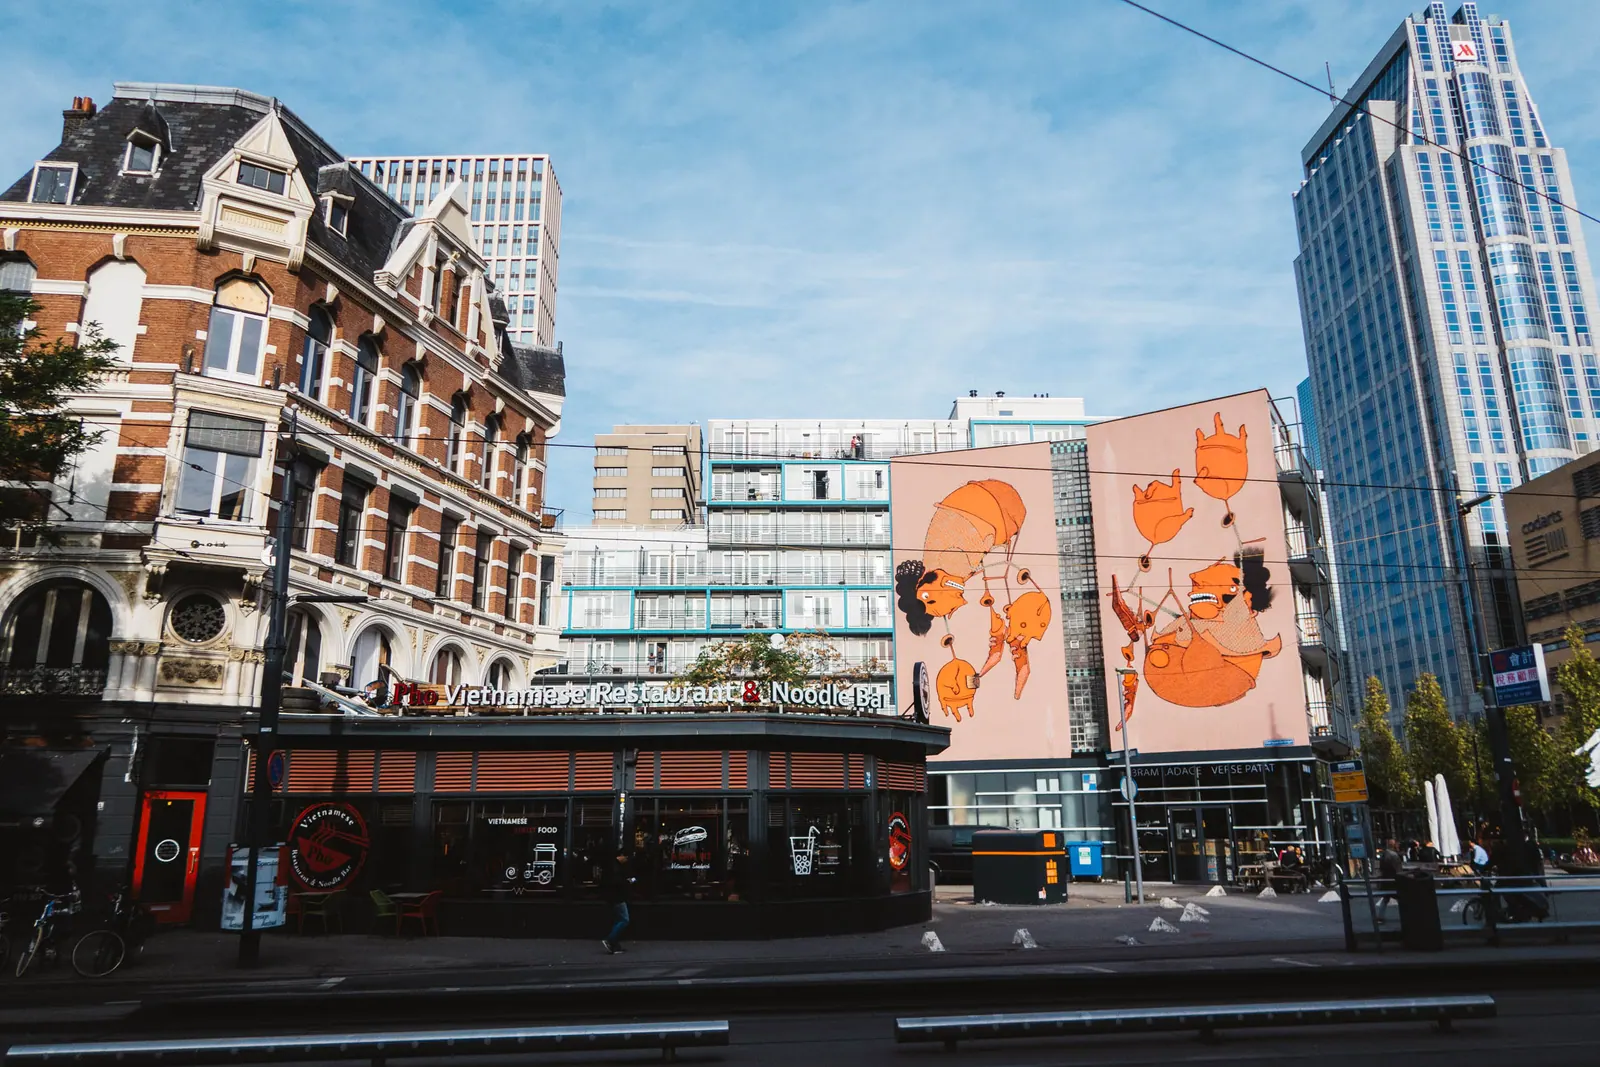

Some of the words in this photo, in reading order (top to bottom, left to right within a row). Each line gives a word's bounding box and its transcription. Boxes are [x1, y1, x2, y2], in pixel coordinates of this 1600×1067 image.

[393, 683, 439, 705] Pho
[445, 684, 587, 706] Vietnamese
[596, 682, 735, 703] Restaurant
[743, 681, 761, 702] &
[771, 681, 852, 706] Noodle
[855, 686, 891, 708] Bar
[300, 809, 354, 828] Vietnamese
[537, 826, 558, 834] FOOD
[292, 849, 309, 883] Restaurant
[318, 876, 341, 888] Noodle
